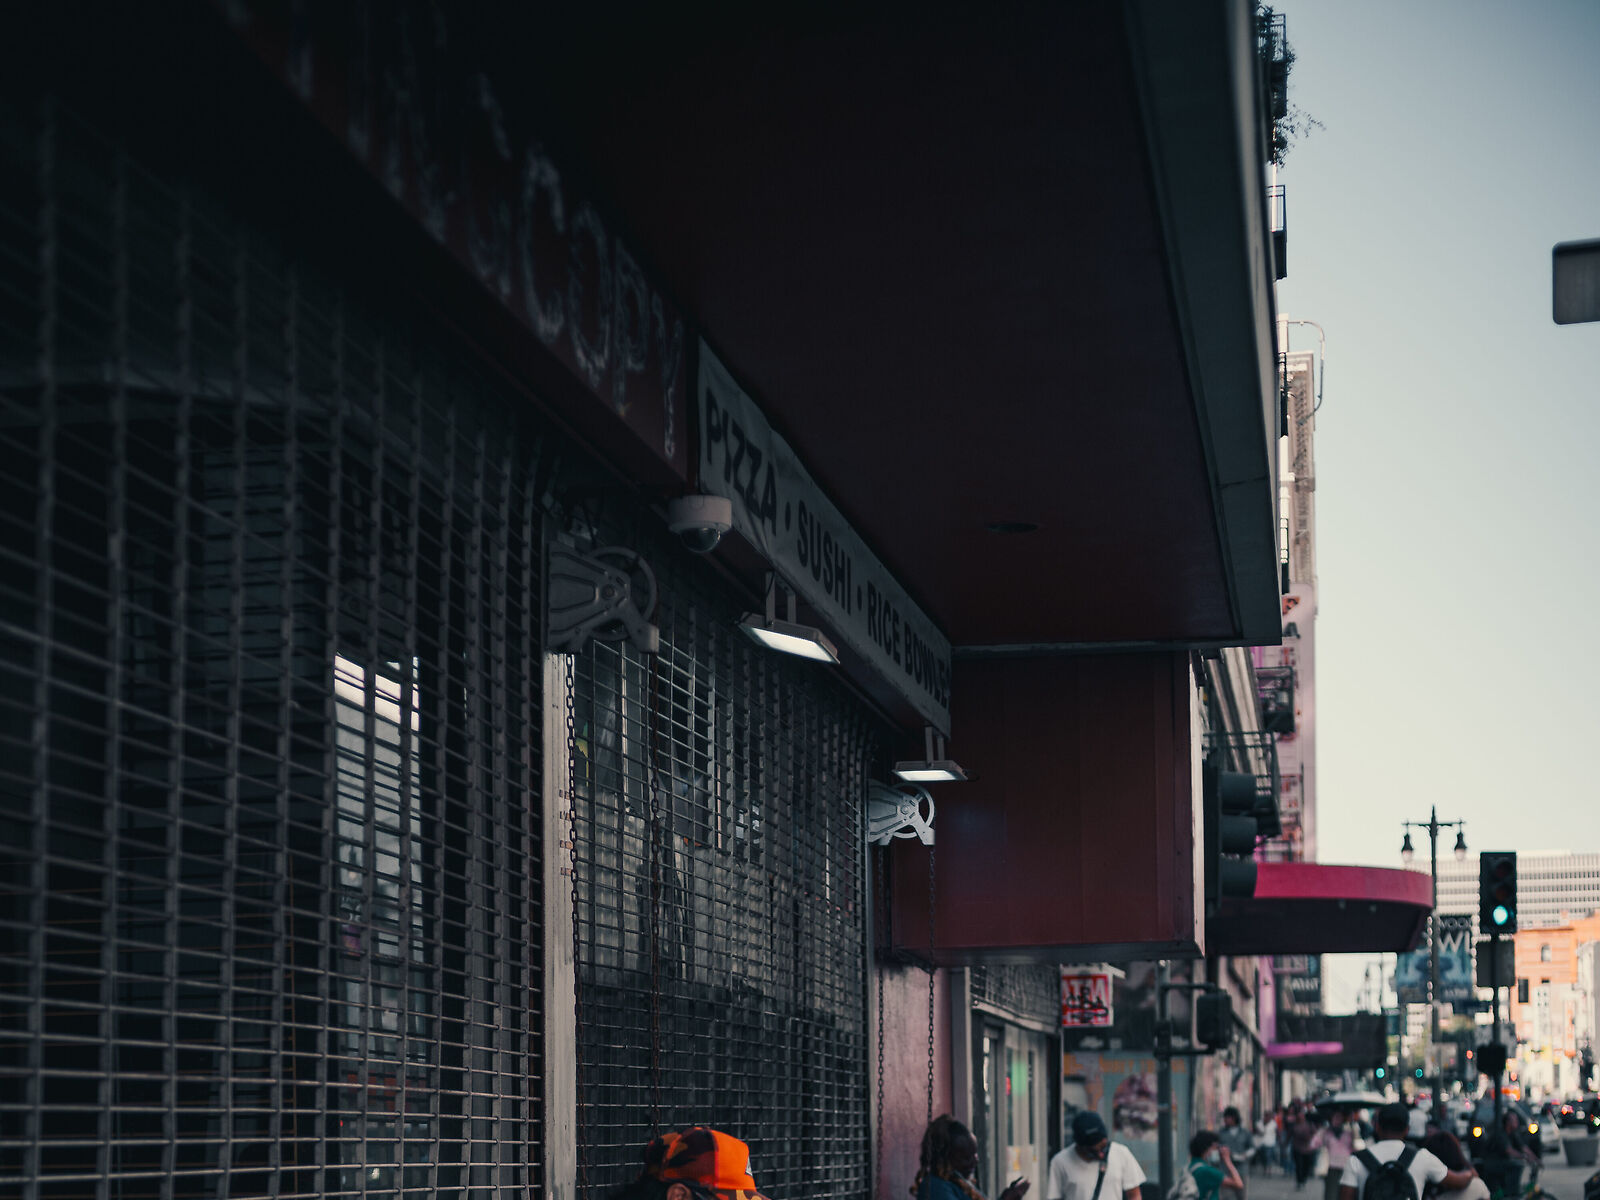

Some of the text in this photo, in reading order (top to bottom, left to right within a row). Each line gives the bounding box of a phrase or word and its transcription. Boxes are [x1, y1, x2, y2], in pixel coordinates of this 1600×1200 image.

[705, 387, 777, 536] PIZZA
[797, 499, 852, 616] SUSHI
[867, 581, 901, 666] RICE
